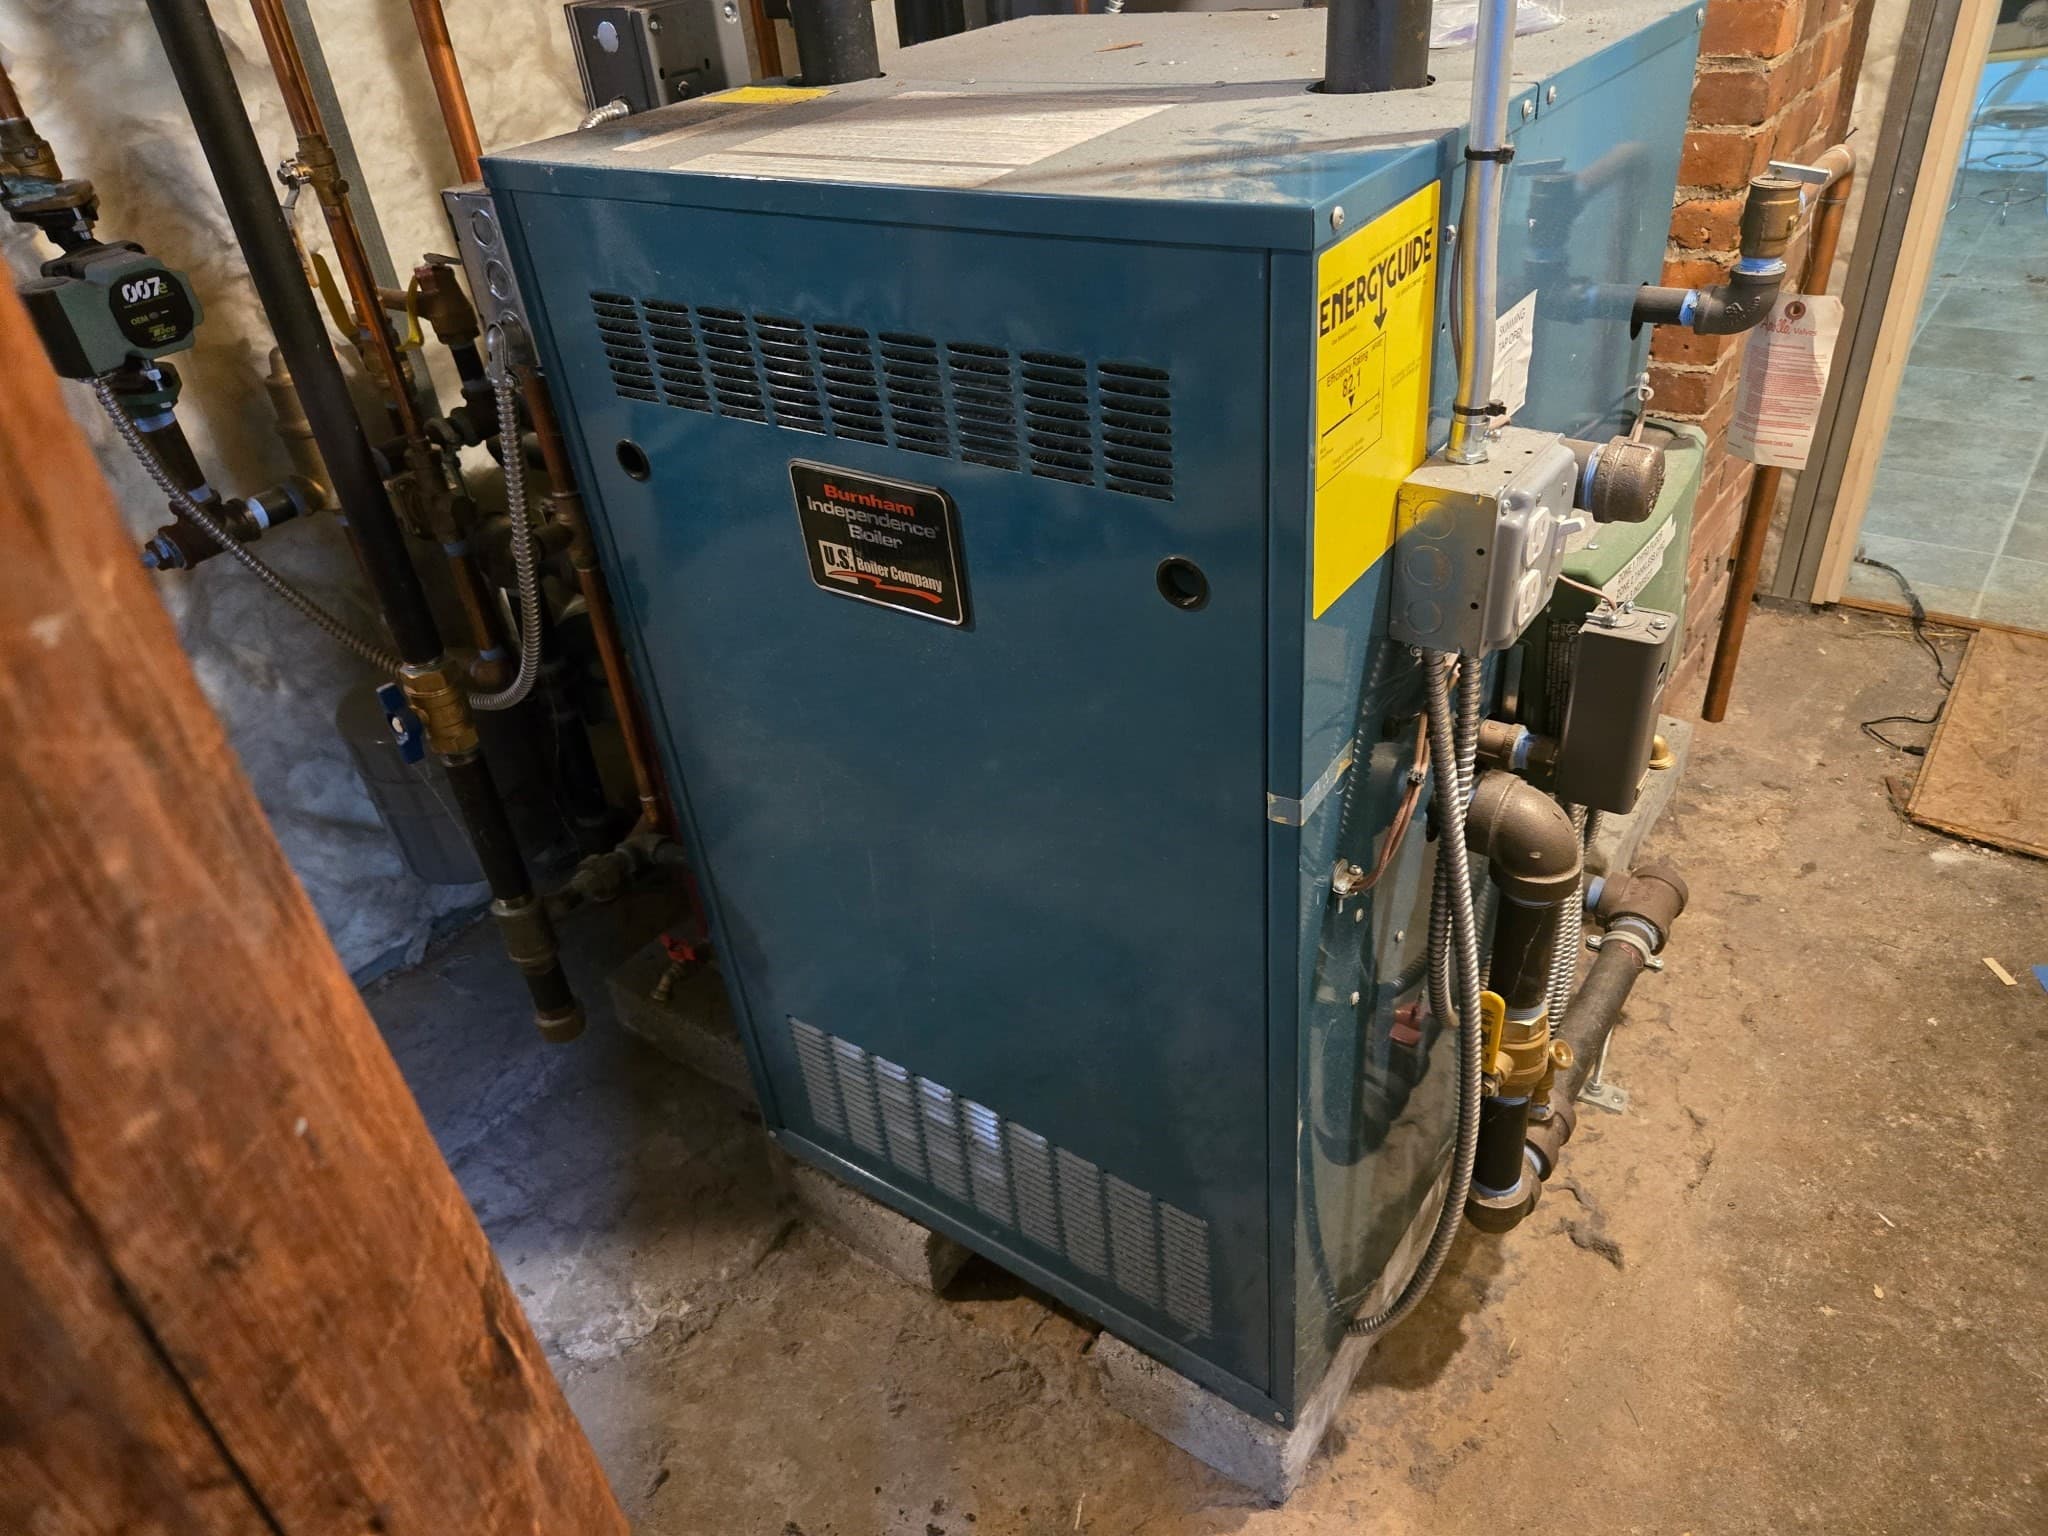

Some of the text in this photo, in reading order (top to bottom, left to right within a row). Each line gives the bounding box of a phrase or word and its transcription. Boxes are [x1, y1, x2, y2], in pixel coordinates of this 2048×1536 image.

[1319, 227, 1433, 338] ENERGYGUIDE
[1326, 350, 1369, 388] Efficiency Rating
[1342, 367, 1361, 398] 82.1
[823, 483, 915, 517] Burnham
[848, 524, 902, 550] Boiler
[823, 545, 855, 572] U.S.
[856, 558, 942, 594] Boiler Company
